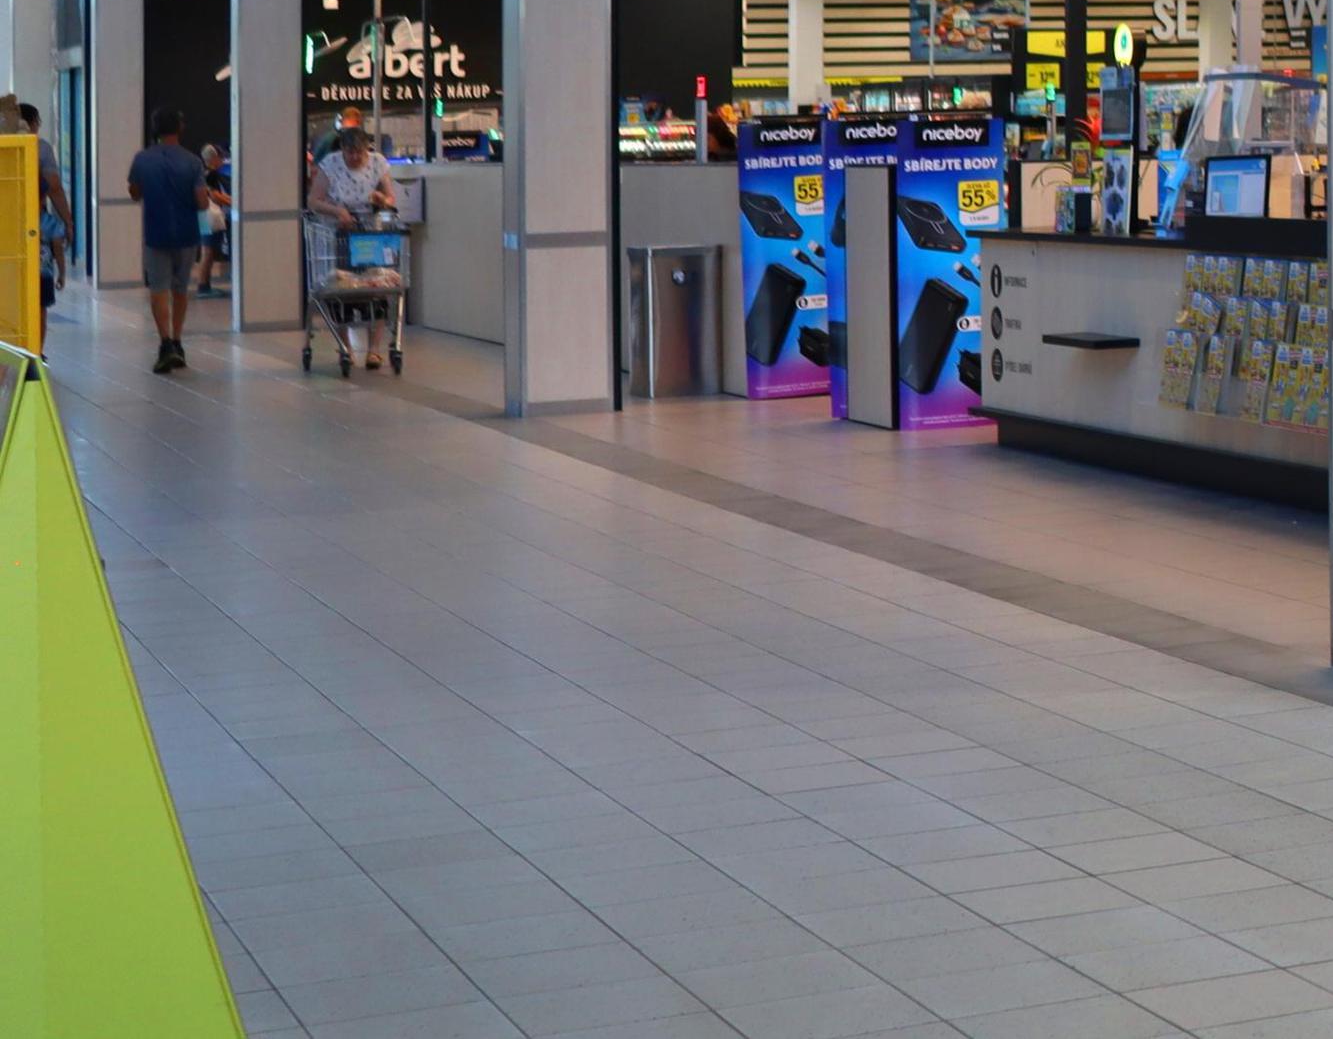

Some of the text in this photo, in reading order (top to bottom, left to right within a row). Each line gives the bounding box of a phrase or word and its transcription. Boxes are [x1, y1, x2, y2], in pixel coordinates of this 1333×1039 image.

[348, 44, 466, 79] abert
[321, 83, 390, 102] DĚKUJEE
[396, 86, 413, 101] ZA
[447, 82, 490, 101] NÁKUP
[760, 125, 816, 143] niceboy
[845, 123, 897, 139] nicebo
[922, 125, 984, 143] niceboy
[744, 154, 823, 170] SBÍREJTE BOD
[904, 157, 962, 172] SBÍREJTE
[964, 157, 998, 170] BODY
